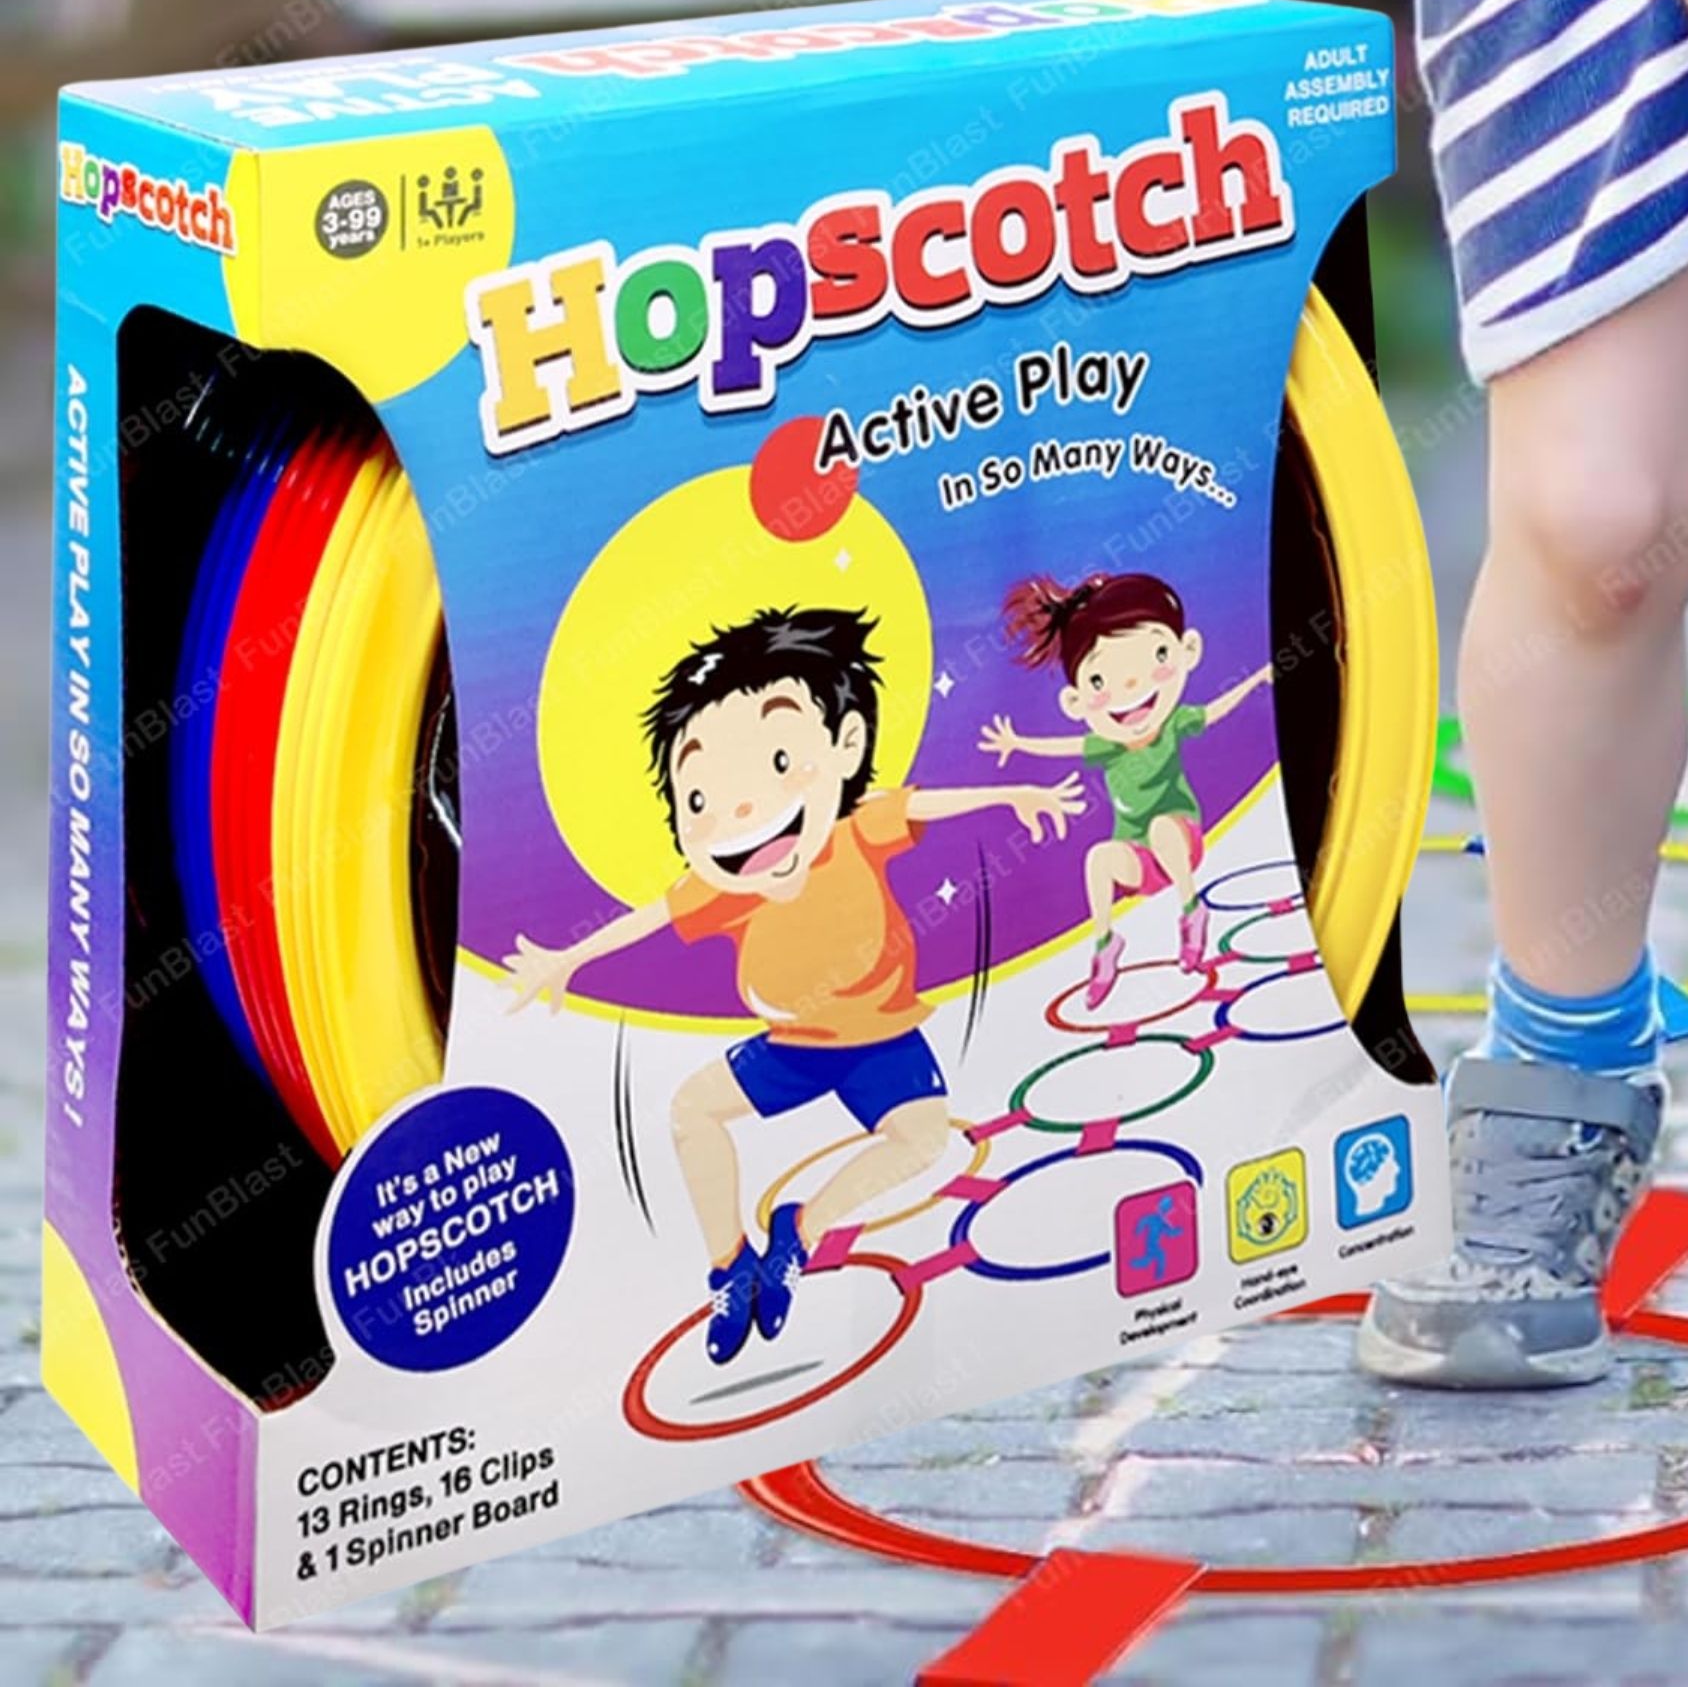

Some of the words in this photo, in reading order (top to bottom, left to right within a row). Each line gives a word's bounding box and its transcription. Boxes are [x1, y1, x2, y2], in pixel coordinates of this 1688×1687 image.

[1285, 69, 1390, 101] ASSEMBLY
[1303, 45, 1368, 71] ADULT
[1287, 97, 1389, 127] REQUIRED
[61, 142, 236, 255] Hopscotch
[322, 207, 382, 234] 3-99
[328, 190, 375, 209] AGES
[328, 228, 375, 250] years
[434, 232, 484, 246] Players
[470, 94, 1292, 450] Hopscotch
[814, 381, 1000, 469] Active
[1018, 343, 1150, 418] Play
[67, 363, 90, 538] ACTIVE
[940, 473, 975, 510] In
[980, 453, 1023, 492] So
[1031, 438, 1123, 478] Many
[1131, 433, 1236, 510] Ways...
[67, 541, 90, 667] PLAY
[68, 670, 91, 723] IN
[69, 728, 91, 800] SO
[68, 809, 91, 955] MANY
[64, 960, 90, 1102] WAYS
[370, 1202, 427, 1240] way
[430, 1183, 456, 1213] to
[461, 1154, 518, 1200] play
[376, 1174, 420, 1208] It's
[423, 1167, 438, 1189] a
[444, 1131, 502, 1176] New
[344, 1169, 561, 1297] HOPSCOTCH
[1339, 1225, 1414, 1260] Concentration
[403, 1240, 517, 1312] Includes
[413, 1269, 520, 1337] Spinner
[1135, 1298, 1183, 1322] Physical
[1234, 1279, 1306, 1310] Coordination
[1119, 1311, 1197, 1345] Development
[297, 1428, 476, 1496] CONTENTS:
[298, 1504, 332, 1538] 13
[340, 1482, 432, 1530] Rings,
[439, 1467, 472, 1496] 16
[480, 1444, 555, 1486] Clips
[297, 1551, 318, 1580] &
[325, 1544, 340, 1572] 1
[344, 1513, 464, 1568] Spinner
[471, 1482, 560, 1529] Board
